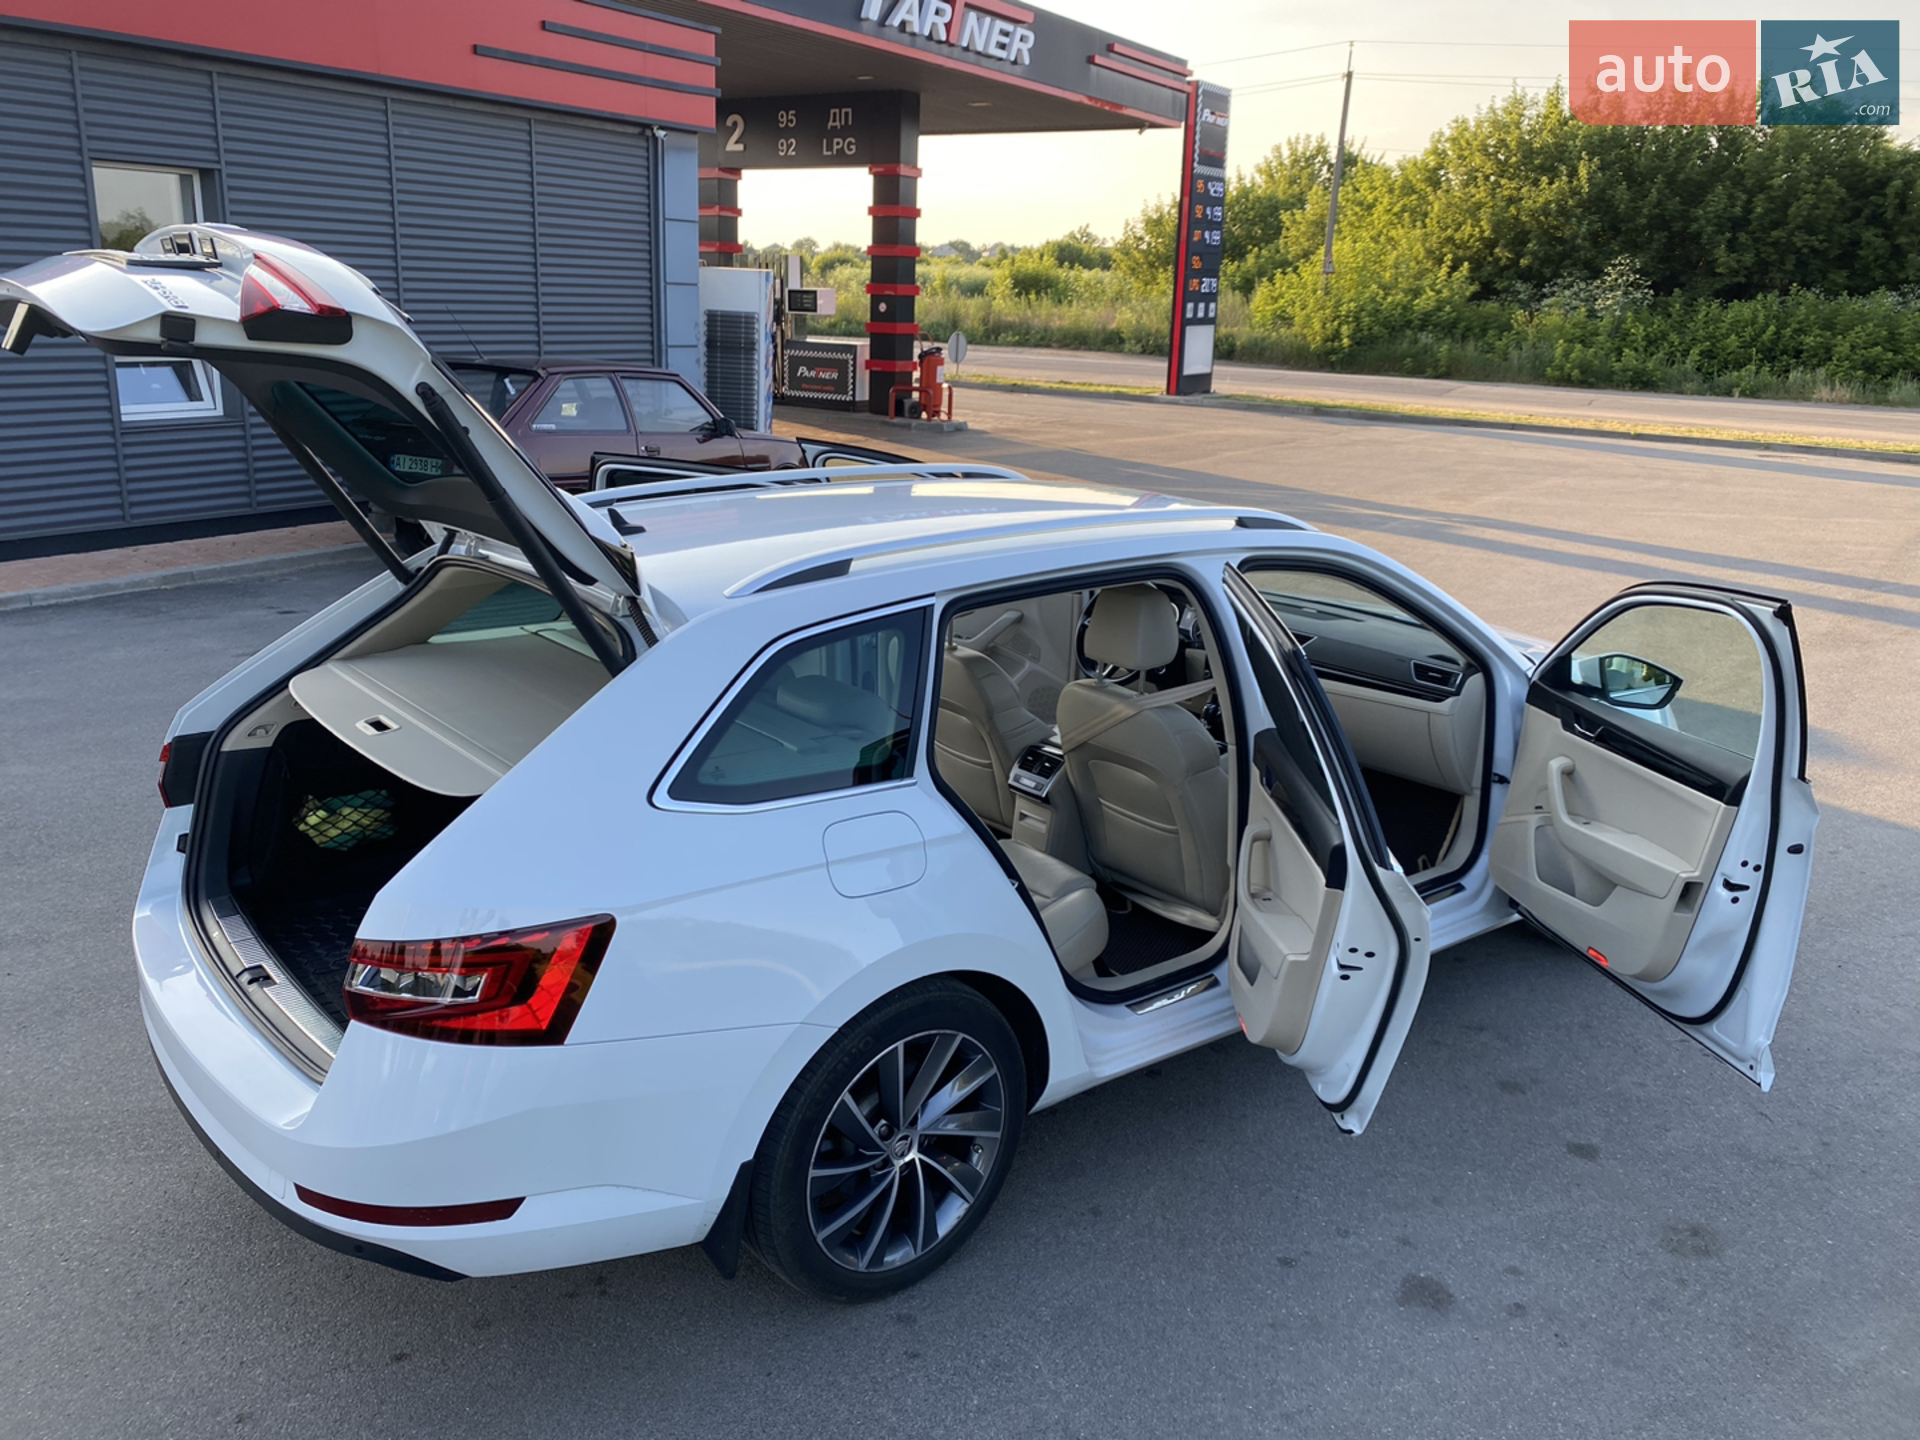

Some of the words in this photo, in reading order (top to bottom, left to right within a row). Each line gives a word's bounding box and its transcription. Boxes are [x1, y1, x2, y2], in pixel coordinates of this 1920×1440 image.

[778, 110, 796, 128] 95
[827, 107, 853, 130] ДП
[725, 114, 745, 151] 2
[778, 138, 797, 156] 92
[823, 137, 856, 155] LPG
[797, 365, 840, 380] PARTNER
